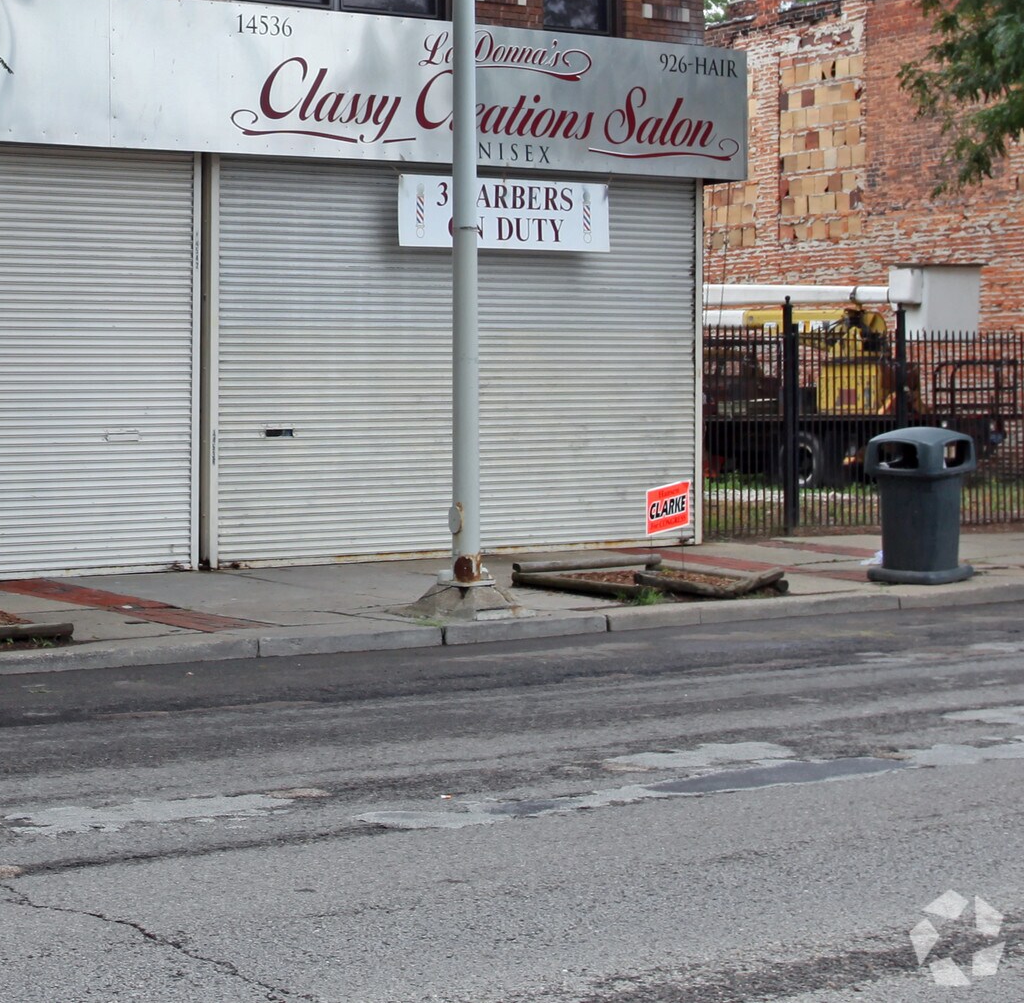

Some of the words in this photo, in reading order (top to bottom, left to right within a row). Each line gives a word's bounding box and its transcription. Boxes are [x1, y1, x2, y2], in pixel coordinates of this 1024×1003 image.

[235, 13, 293, 38] 14536
[659, 53, 738, 78] 926-HAIR
[259, 56, 402, 144] Classy
[415, 69, 595, 141] Ceations
[604, 86, 717, 148] Salon
[478, 141, 551, 164] NISEX
[436, 181, 449, 207] 3
[476, 183, 574, 212] ARBERS
[496, 216, 565, 243] DUTY
[649, 494, 686, 520] CLARKE
